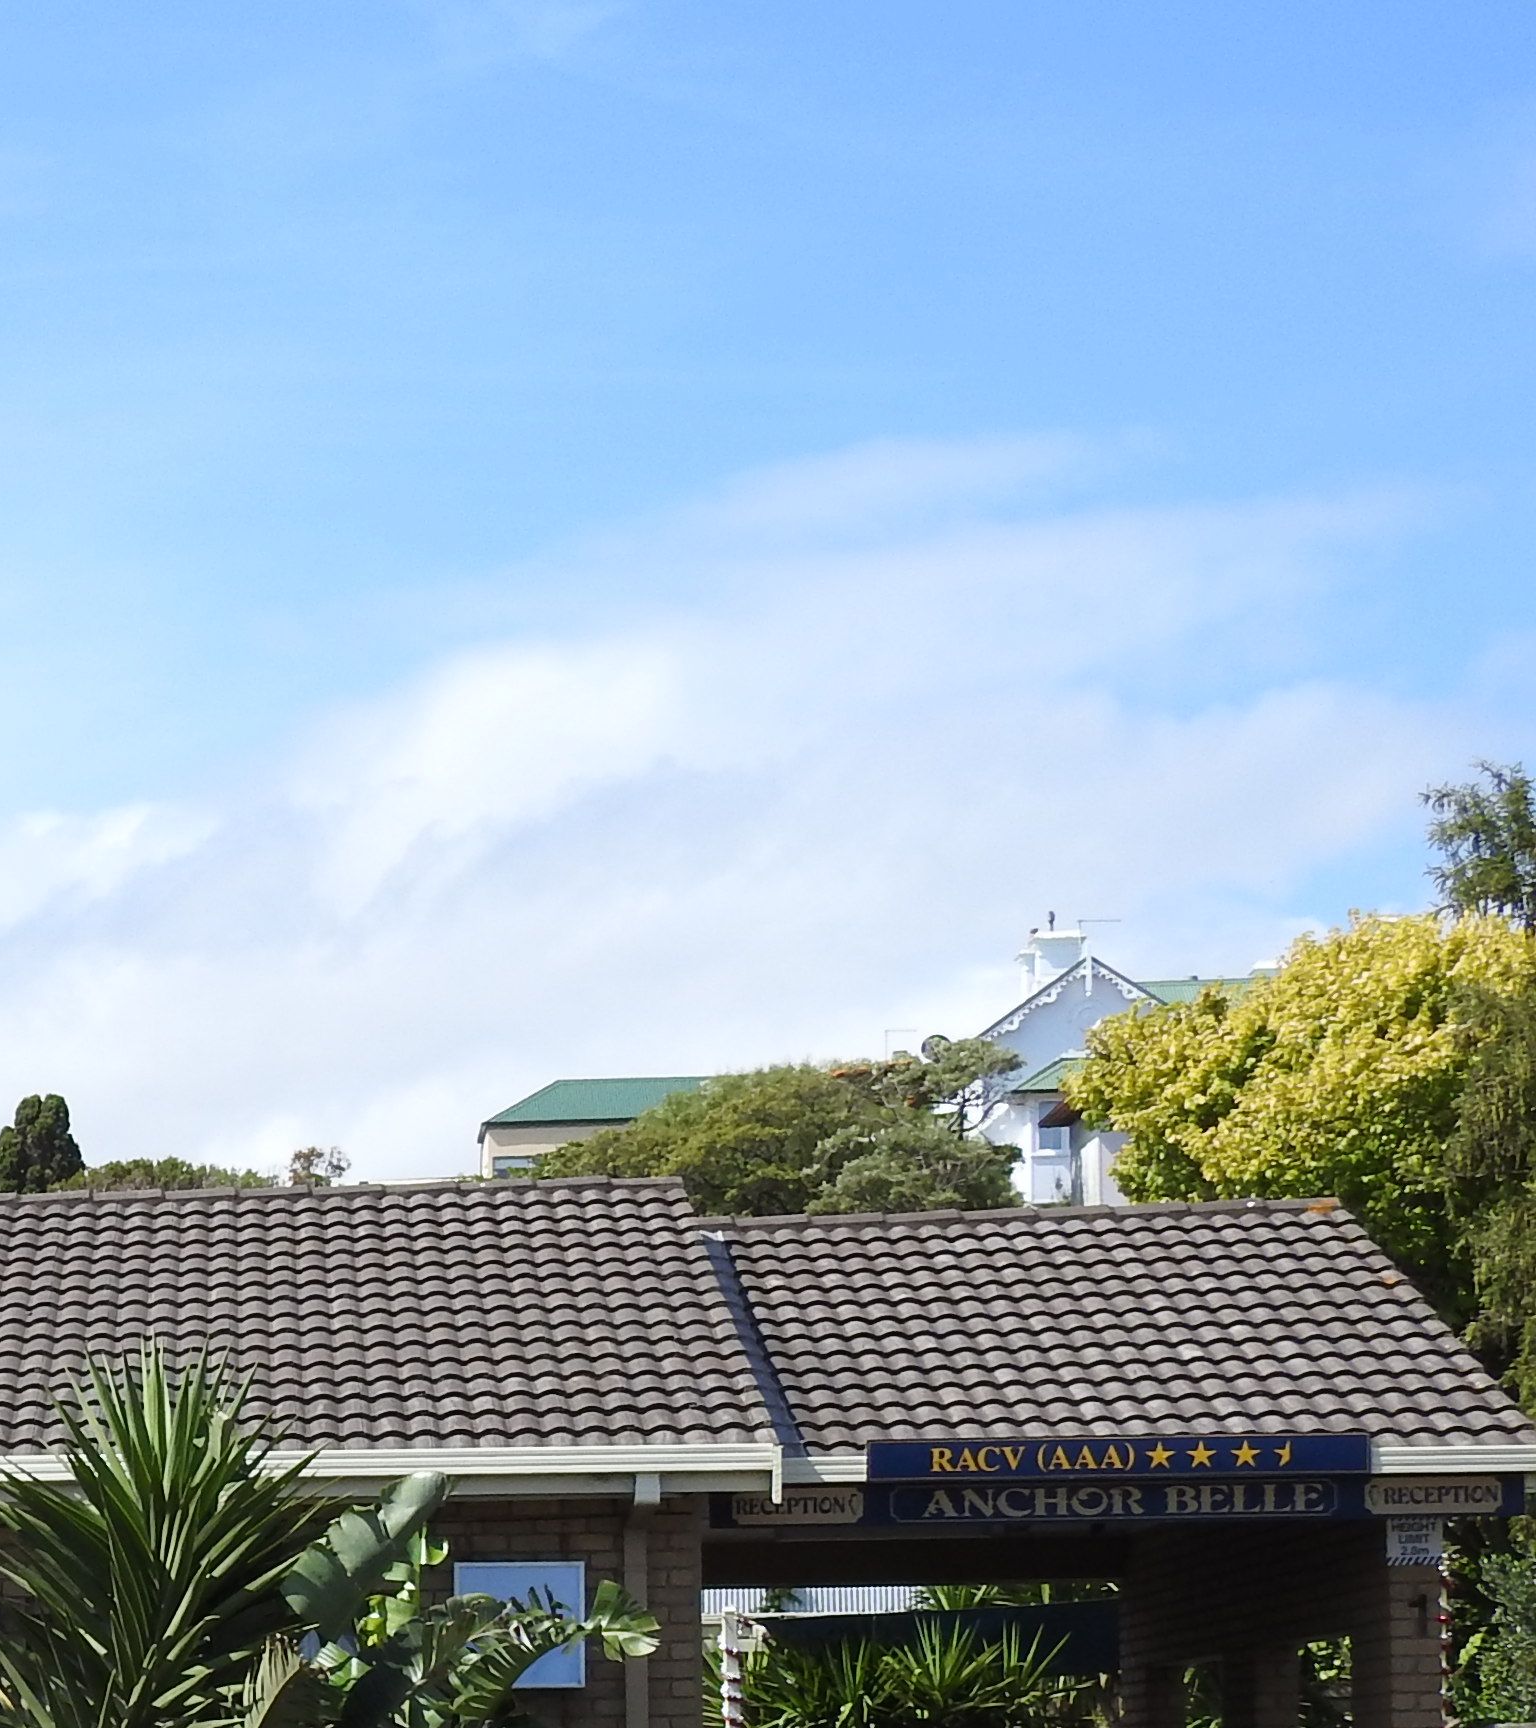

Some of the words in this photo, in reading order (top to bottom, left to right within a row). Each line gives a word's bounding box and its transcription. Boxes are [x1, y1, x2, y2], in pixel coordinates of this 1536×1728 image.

[929, 1446, 1025, 1472] RACV
[1036, 1444, 1135, 1473] (AAA)
[922, 1488, 1144, 1518] ANCHOR
[1165, 1483, 1326, 1514] BELLE
[1383, 1485, 1498, 1505] RECEPTION
